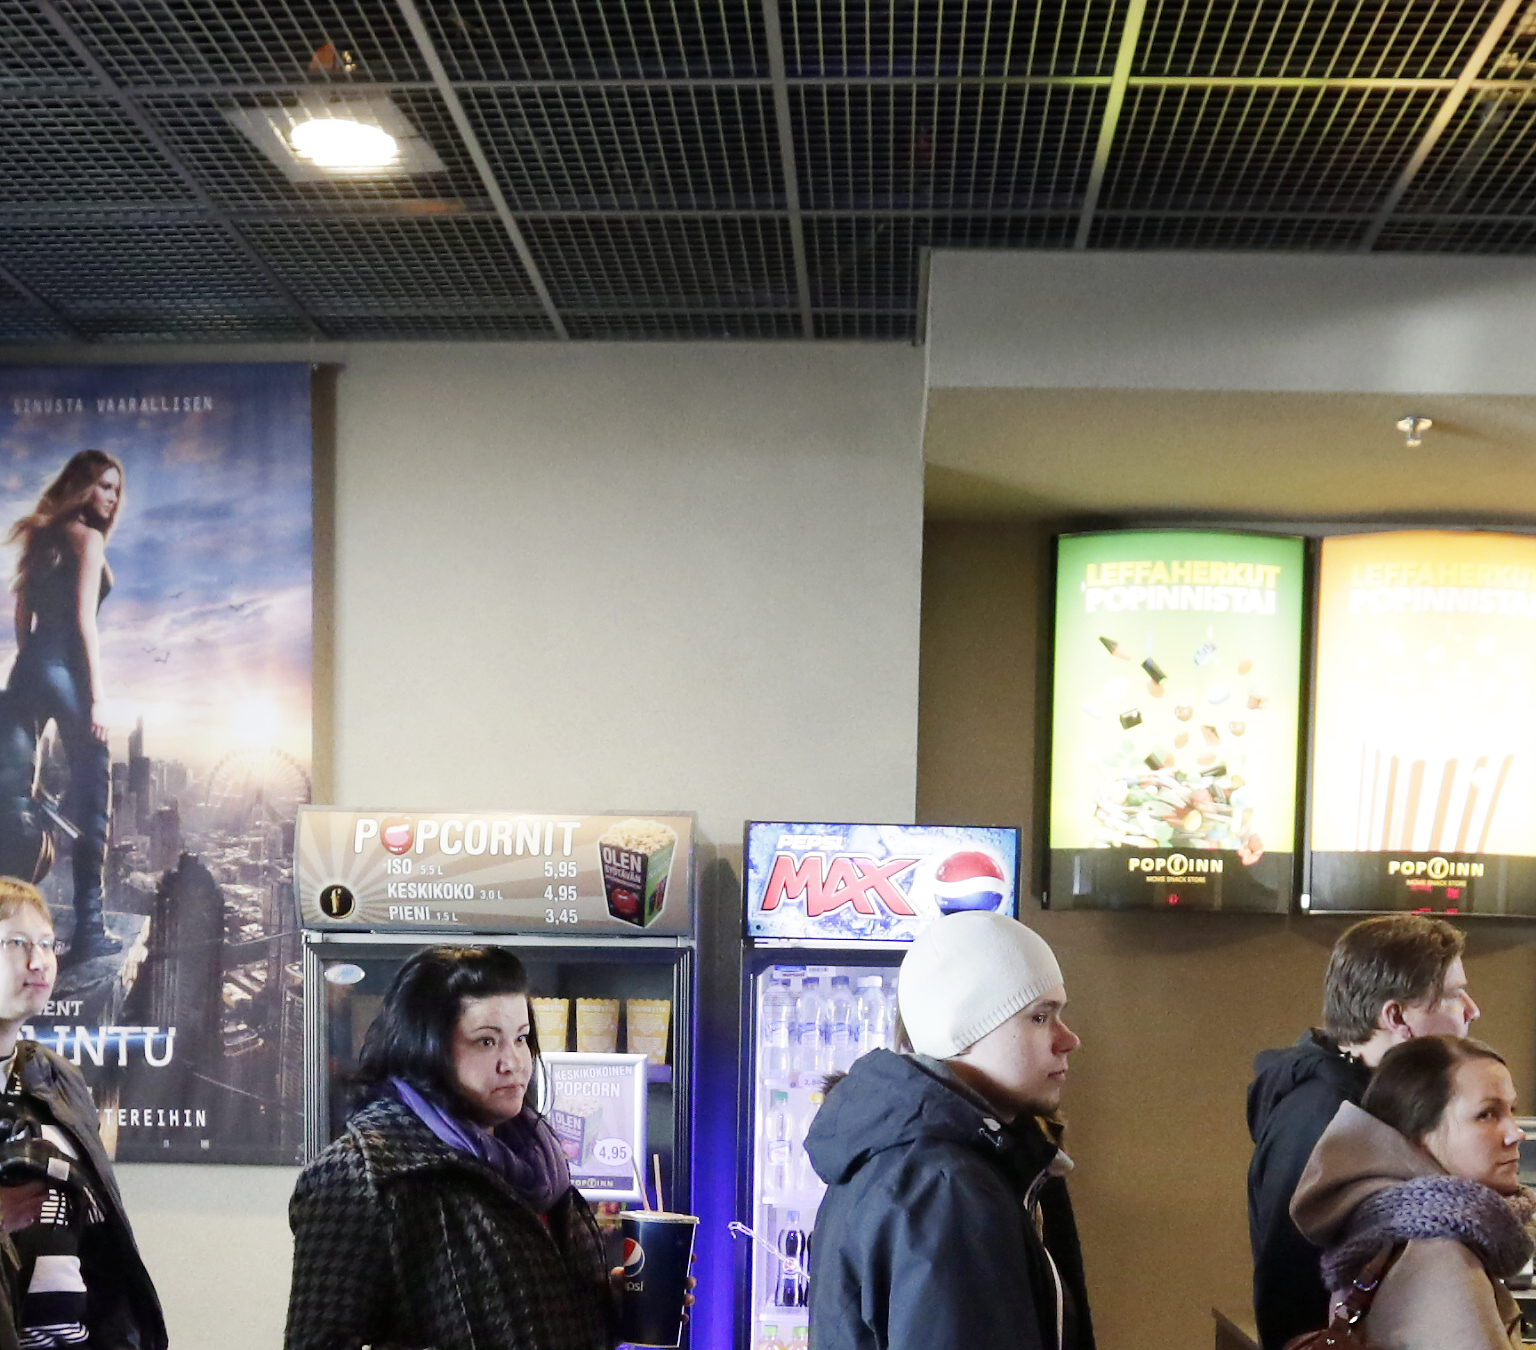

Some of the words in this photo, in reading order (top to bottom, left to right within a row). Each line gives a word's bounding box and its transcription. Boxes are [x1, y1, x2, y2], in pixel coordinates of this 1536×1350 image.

[97, 396, 213, 413] VAARALLISEN
[1086, 560, 1282, 588] LEFFAHERKUT
[354, 817, 581, 857] POPCORNIT
[387, 858, 413, 875] ISO
[544, 861, 578, 879] 5,95
[603, 847, 642, 873] OLEN
[387, 882, 475, 900] KESKIKOKO
[544, 885, 578, 903] 4,95
[760, 855, 923, 918] MAX
[389, 905, 431, 921] PIENI
[545, 908, 579, 926] 3,45
[41, 1000, 83, 1016] ENT
[20, 1025, 177, 1067] INTU
[554, 1065, 633, 1080] KESKIKOKOINEN
[555, 1081, 621, 1097] POPCORN
[96, 1108, 206, 1127] TEREIHIN
[555, 1112, 582, 1130] OLEN
[599, 1146, 627, 1160] 4,95
[626, 1281, 644, 1292] psi
